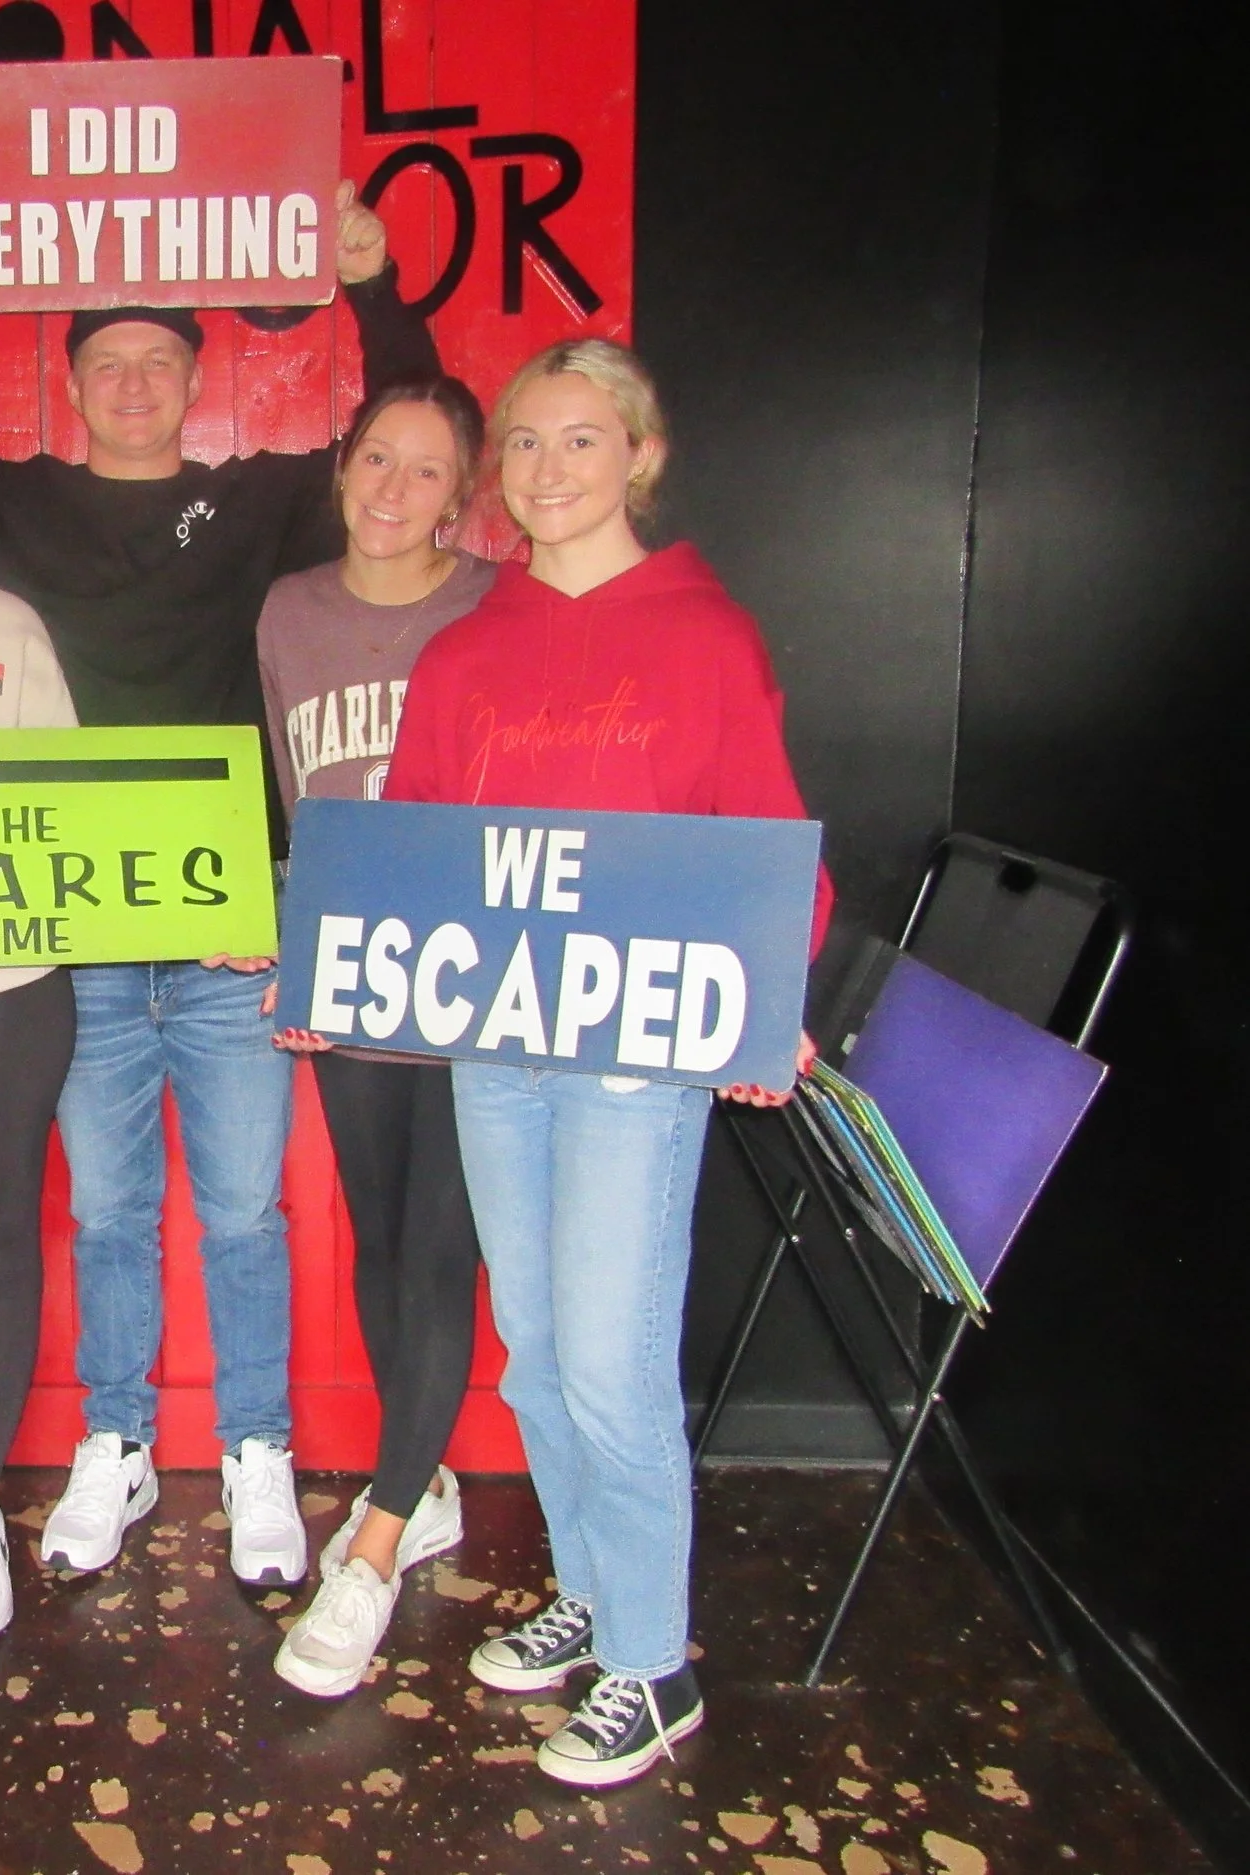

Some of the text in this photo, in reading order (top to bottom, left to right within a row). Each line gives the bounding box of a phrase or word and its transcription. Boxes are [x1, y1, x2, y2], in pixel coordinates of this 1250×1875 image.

[30, 105, 178, 176] I DID
[1, 806, 61, 844] HE
[483, 826, 587, 913] WE
[1, 916, 73, 955] ME
[309, 914, 747, 1073] ESCAPED
